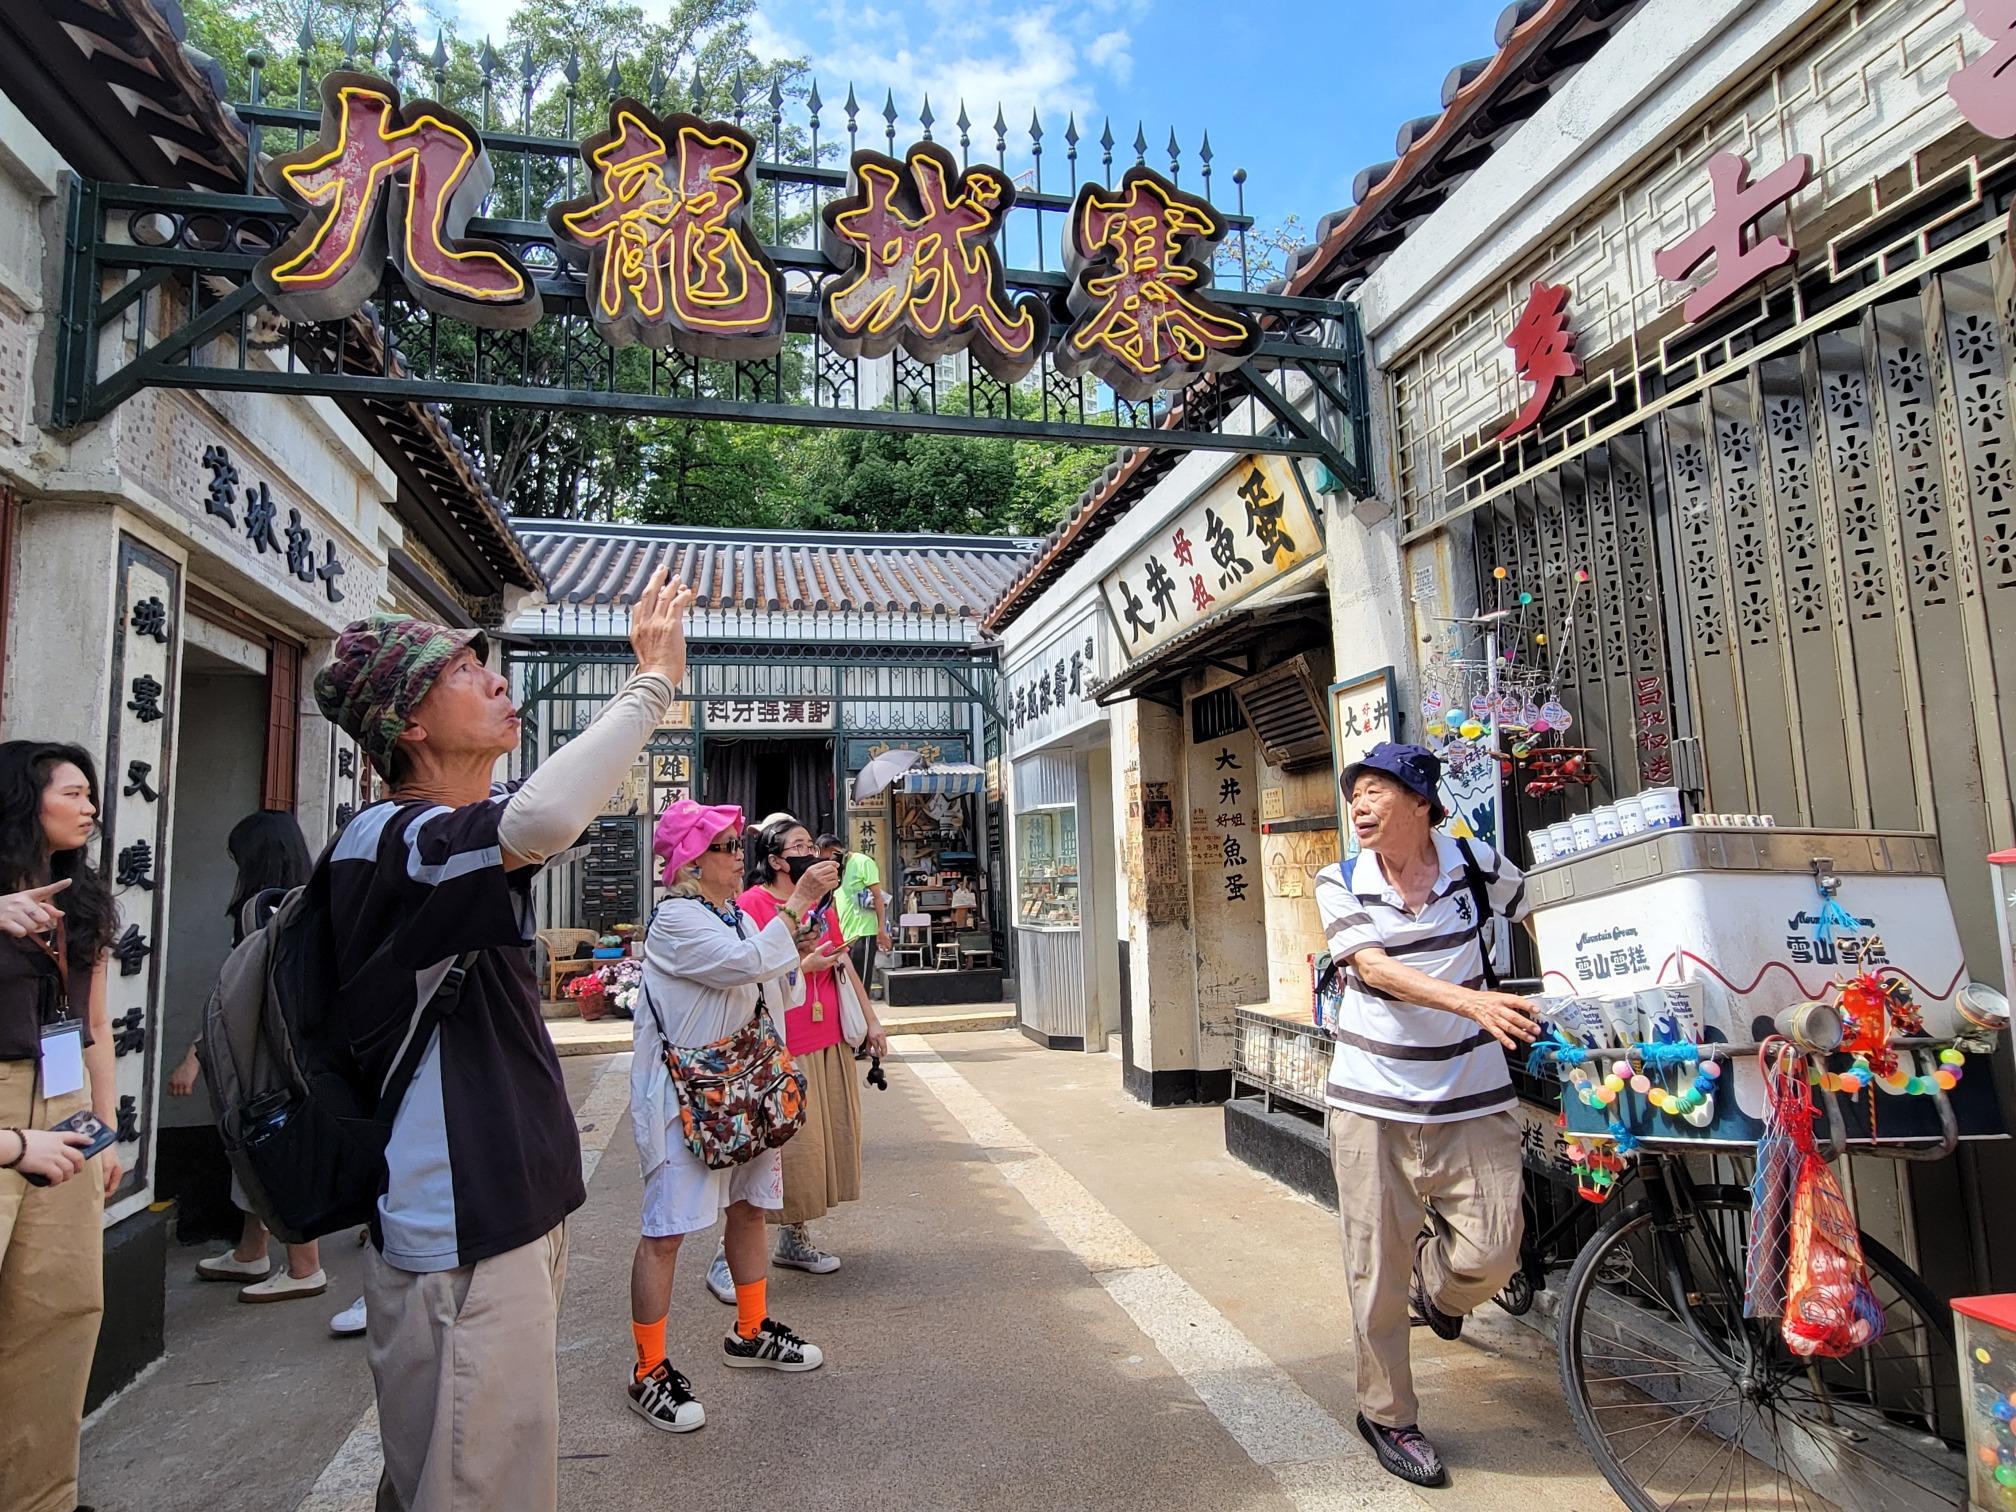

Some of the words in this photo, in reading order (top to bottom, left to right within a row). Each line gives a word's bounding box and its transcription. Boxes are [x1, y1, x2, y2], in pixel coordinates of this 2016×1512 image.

[262, 78, 1256, 387] 九龍城寨
[1575, 944, 1651, 981] 雪山雪糕
